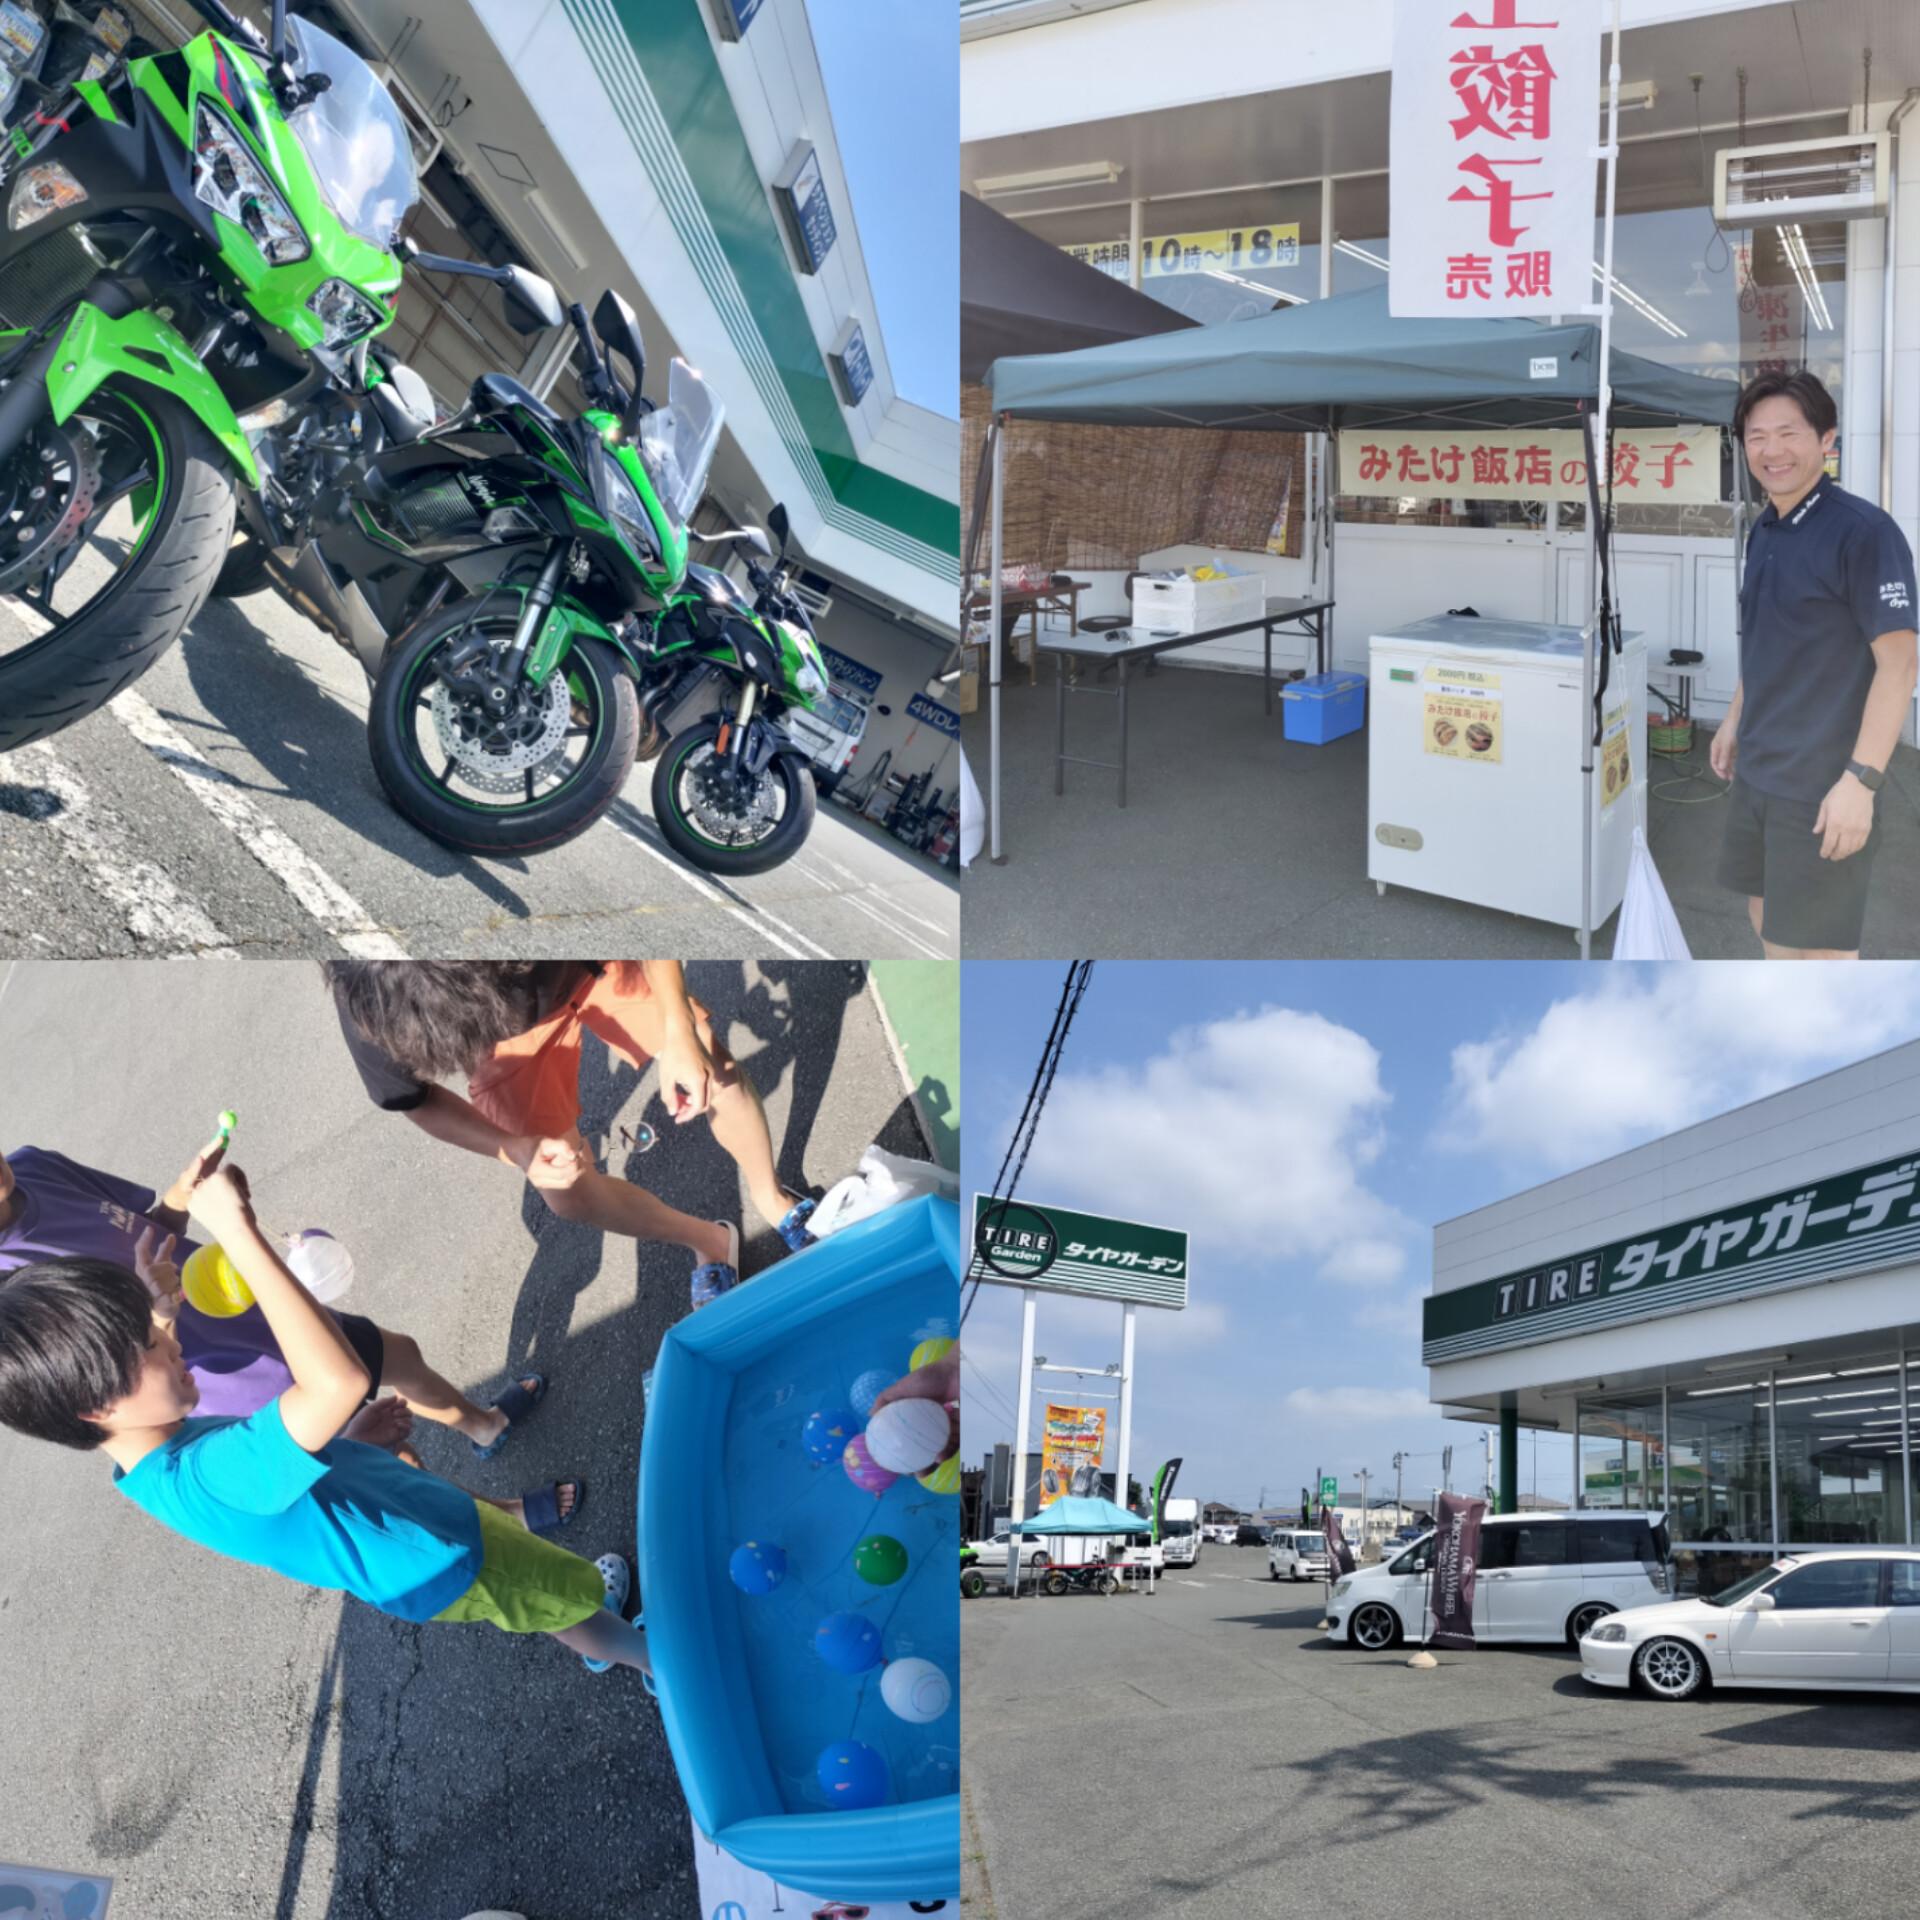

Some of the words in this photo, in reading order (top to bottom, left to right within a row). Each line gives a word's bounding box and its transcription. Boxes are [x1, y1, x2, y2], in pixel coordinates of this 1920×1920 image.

[467, 474, 497, 504] Ninja
[910, 701, 960, 732] 4WDレ
[984, 1226, 1048, 1250] TIRE
[991, 1246, 1042, 1263] Garden
[1063, 1242, 1185, 1274] タイヤガーデン
[1500, 1260, 1597, 1315] TIRE
